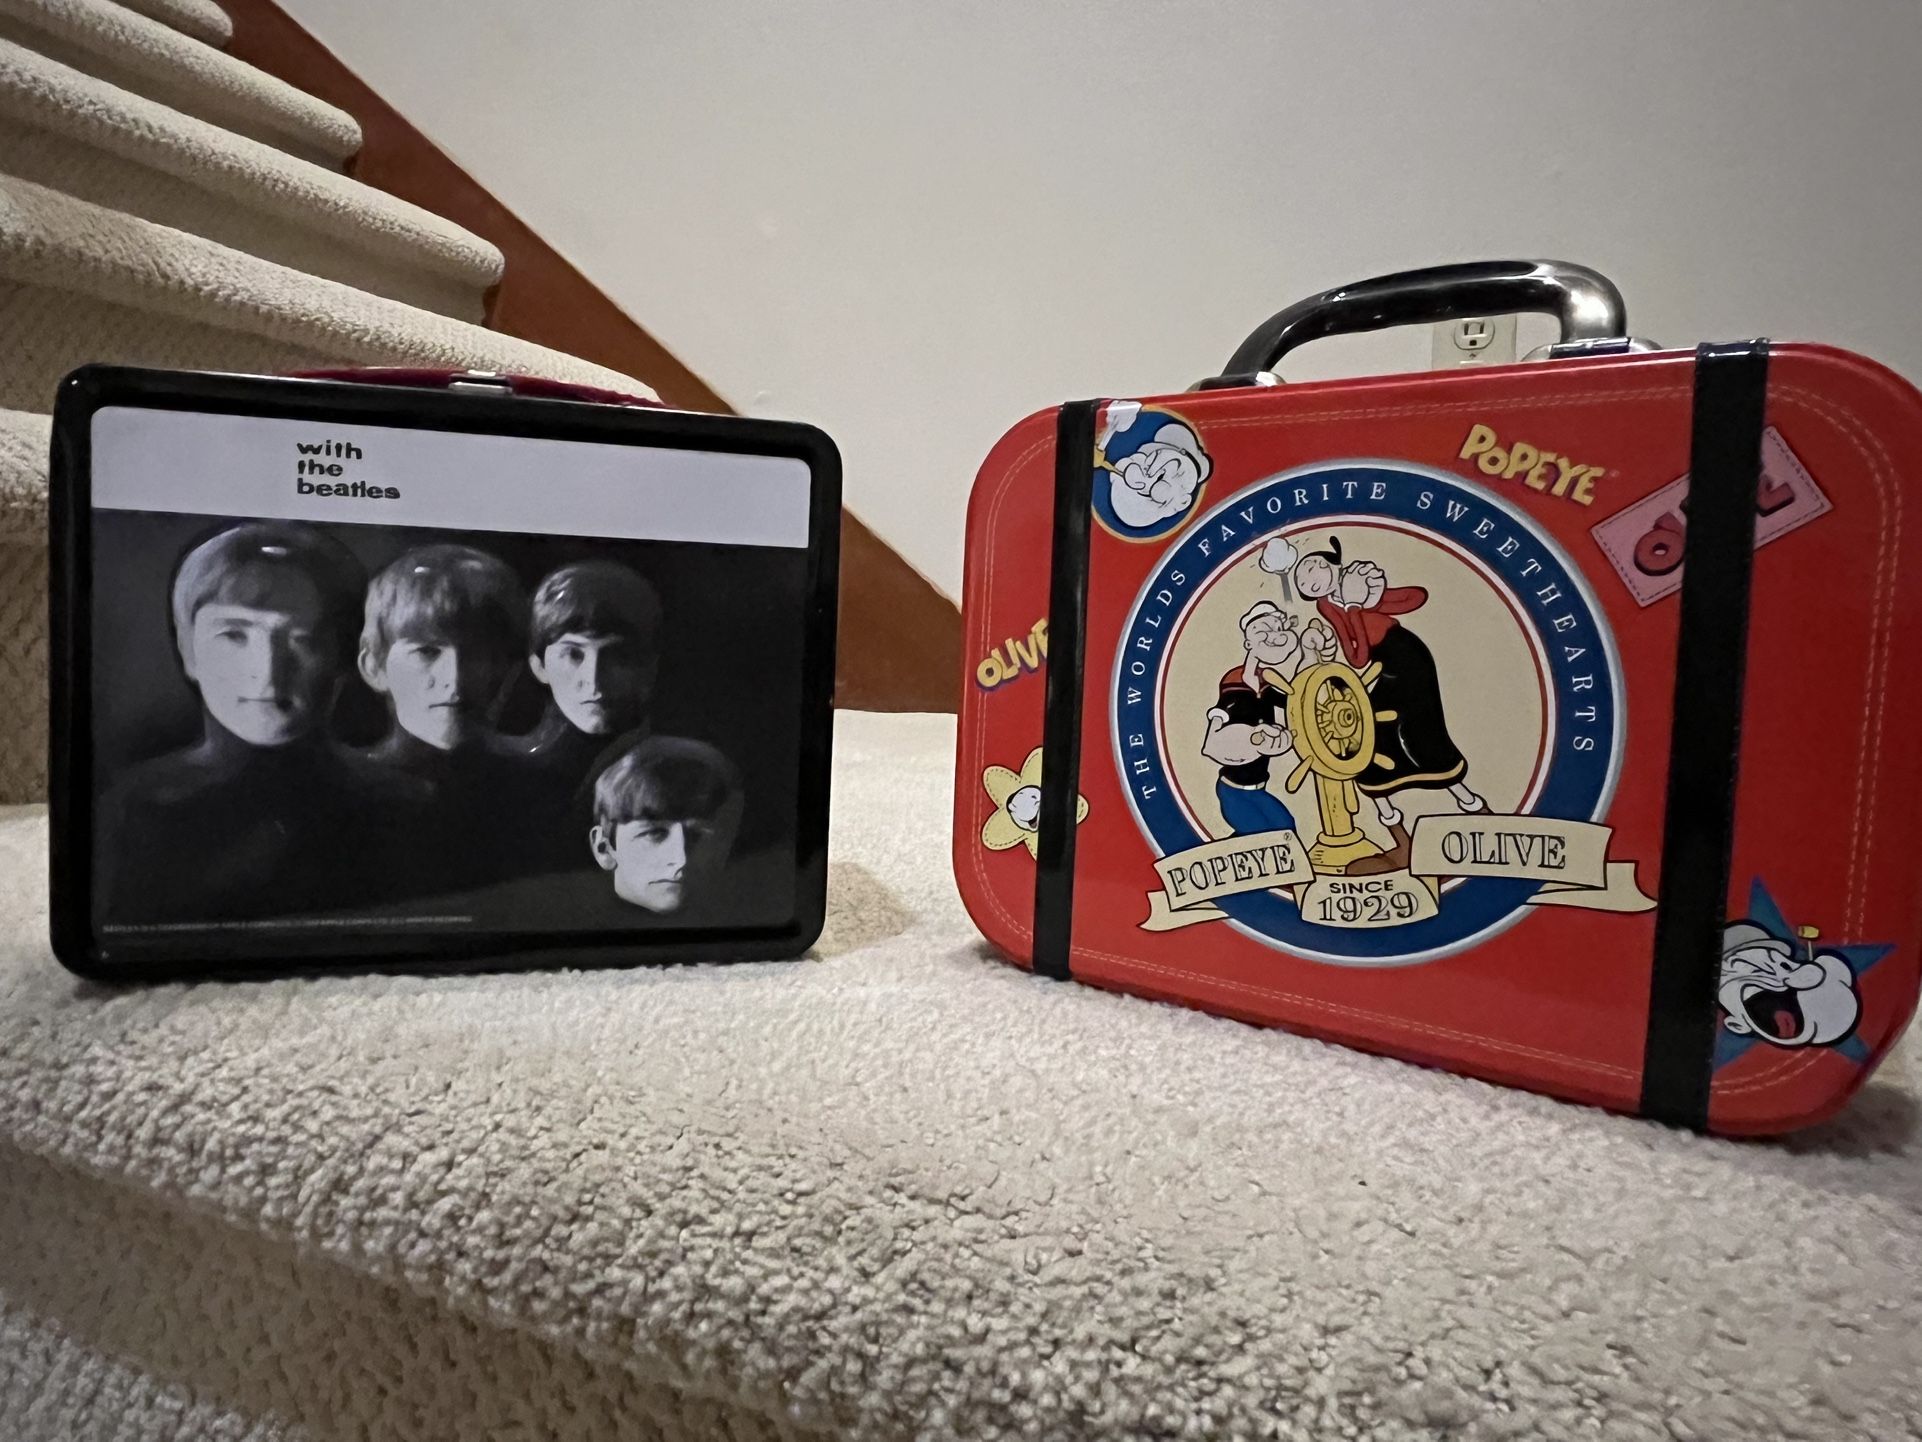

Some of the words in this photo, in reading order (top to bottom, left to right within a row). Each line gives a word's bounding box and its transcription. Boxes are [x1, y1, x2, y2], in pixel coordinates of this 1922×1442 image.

[297, 440, 362, 460] with
[298, 459, 343, 477] the
[1459, 423, 1605, 506] POPEYE
[297, 478, 400, 499] beatles
[1198, 477, 1386, 558] FAVORITE
[1127, 569, 1186, 705] WORLDS
[1416, 490, 1597, 751] SWEETHEARTS
[1129, 733, 1157, 799] THE
[1167, 843, 1296, 898] POPEYE
[1441, 830, 1566, 869] OLIVE
[1317, 891, 1419, 923] 1929
[1329, 879, 1394, 894] SINCE
